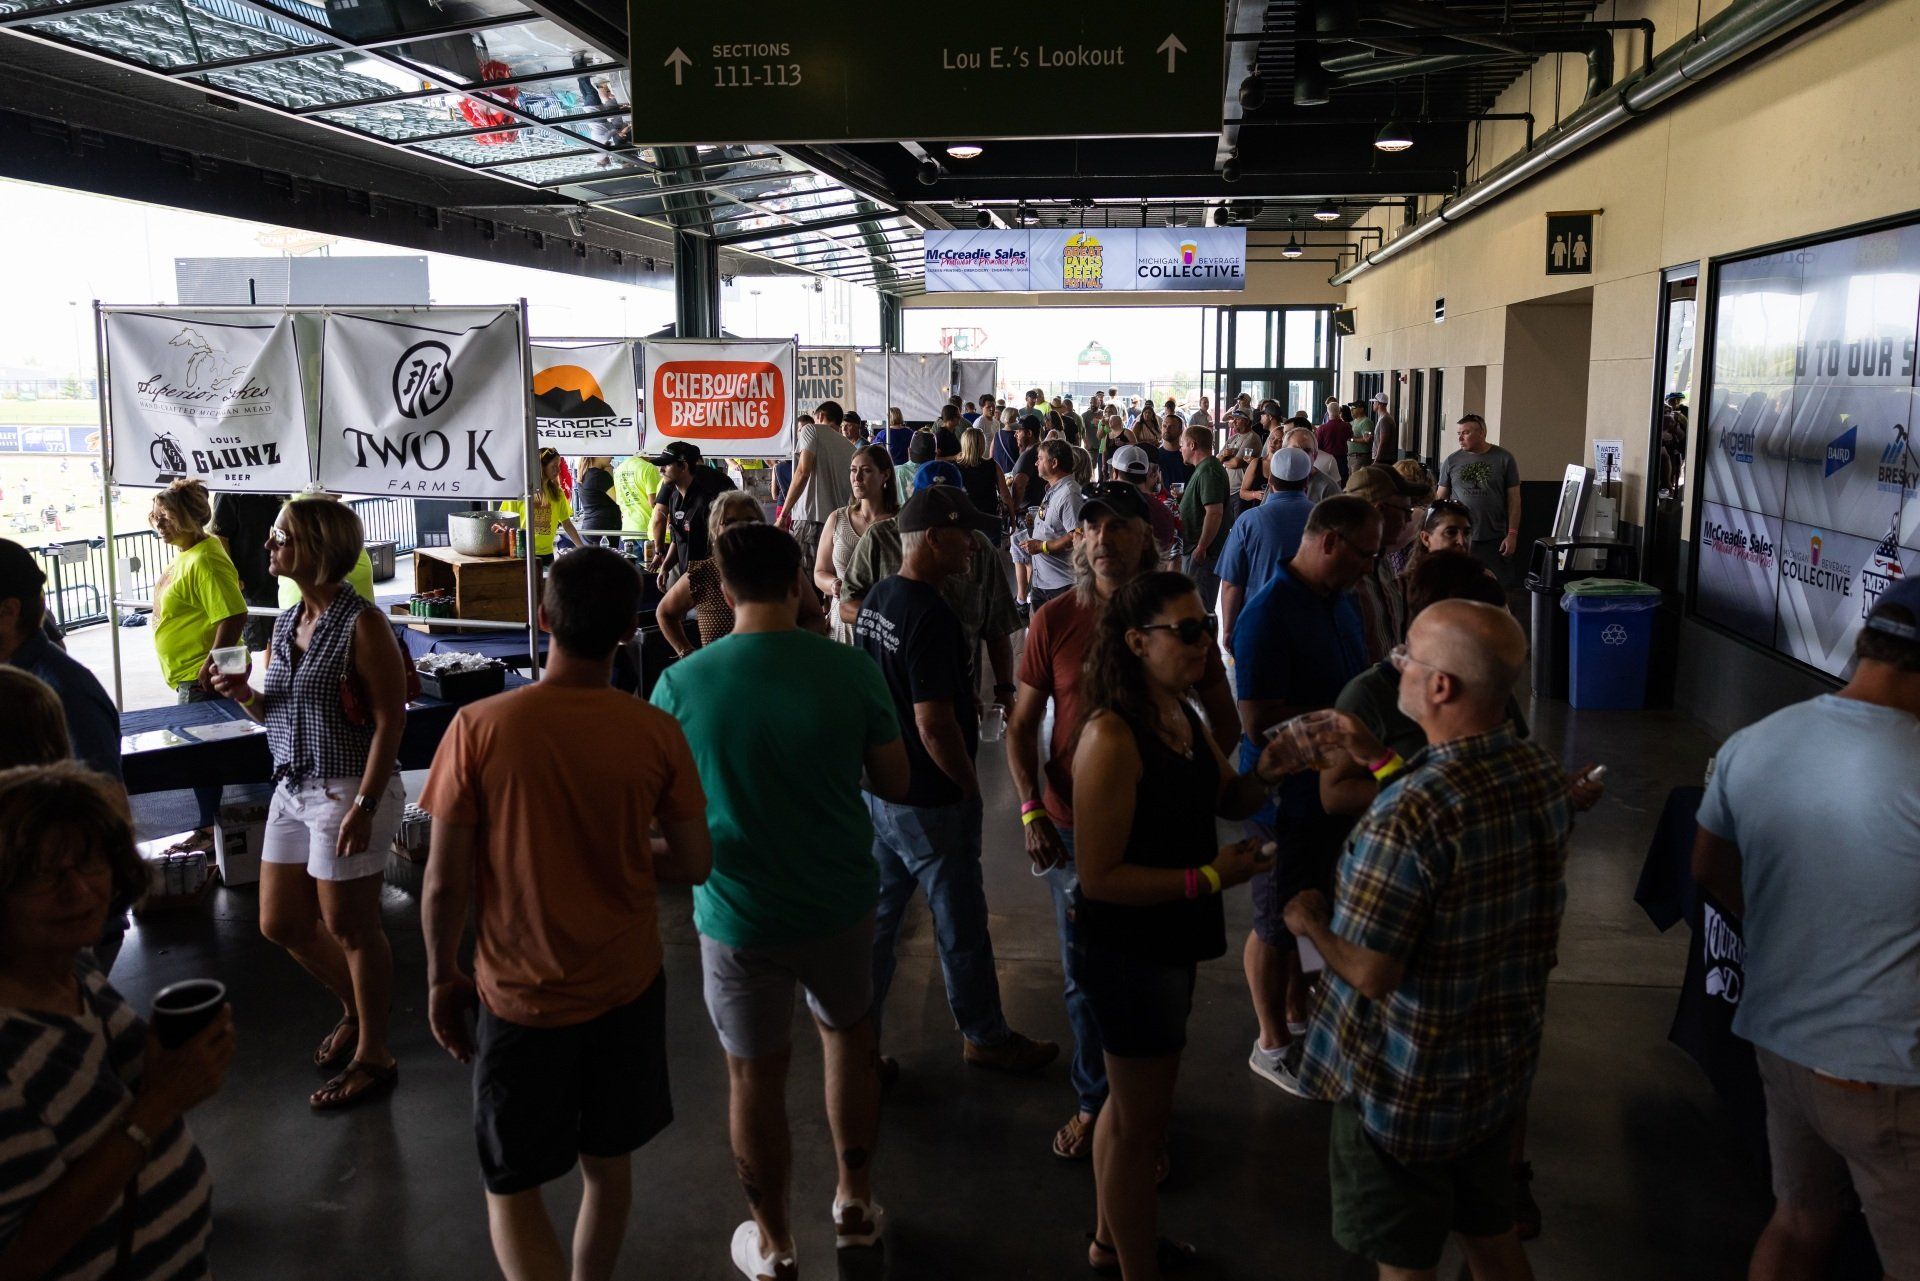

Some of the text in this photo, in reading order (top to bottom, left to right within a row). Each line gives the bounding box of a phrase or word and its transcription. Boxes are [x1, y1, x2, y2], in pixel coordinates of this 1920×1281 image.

[712, 43, 790, 58] SECTIONS
[943, 44, 1125, 69] Lou E.'s Lookout
[714, 64, 802, 87] 111-113
[926, 248, 1026, 260] McCreadie Sales
[1064, 246, 1103, 256] GREAT
[1064, 256, 1102, 266] LAKES
[1064, 266, 1102, 278] BEER
[1138, 265, 1240, 278] COLLECTIVE
[798, 356, 844, 376] GERS
[1816, 340, 1840, 376] TO
[1848, 338, 1893, 376] OUR
[138, 374, 218, 402] Superior
[662, 372, 776, 400] CHEBOYGAN
[798, 378, 844, 398] WING
[760, 400, 770, 428] CO
[210, 436, 242, 444] LOUIS
[1719, 426, 1755, 456] Argent
[192, 442, 281, 474] GLUNZ
[342, 427, 506, 482] TWO K
[1827, 448, 1850, 462] BAIRD
[388, 480, 460, 492] FARMS
[1878, 466, 1919, 490] BRESKY
[1704, 520, 1773, 556] McCreadie Sales
[1782, 560, 1850, 596] COLLECTIVE
[1822, 559, 1850, 576] BEVERAGE
